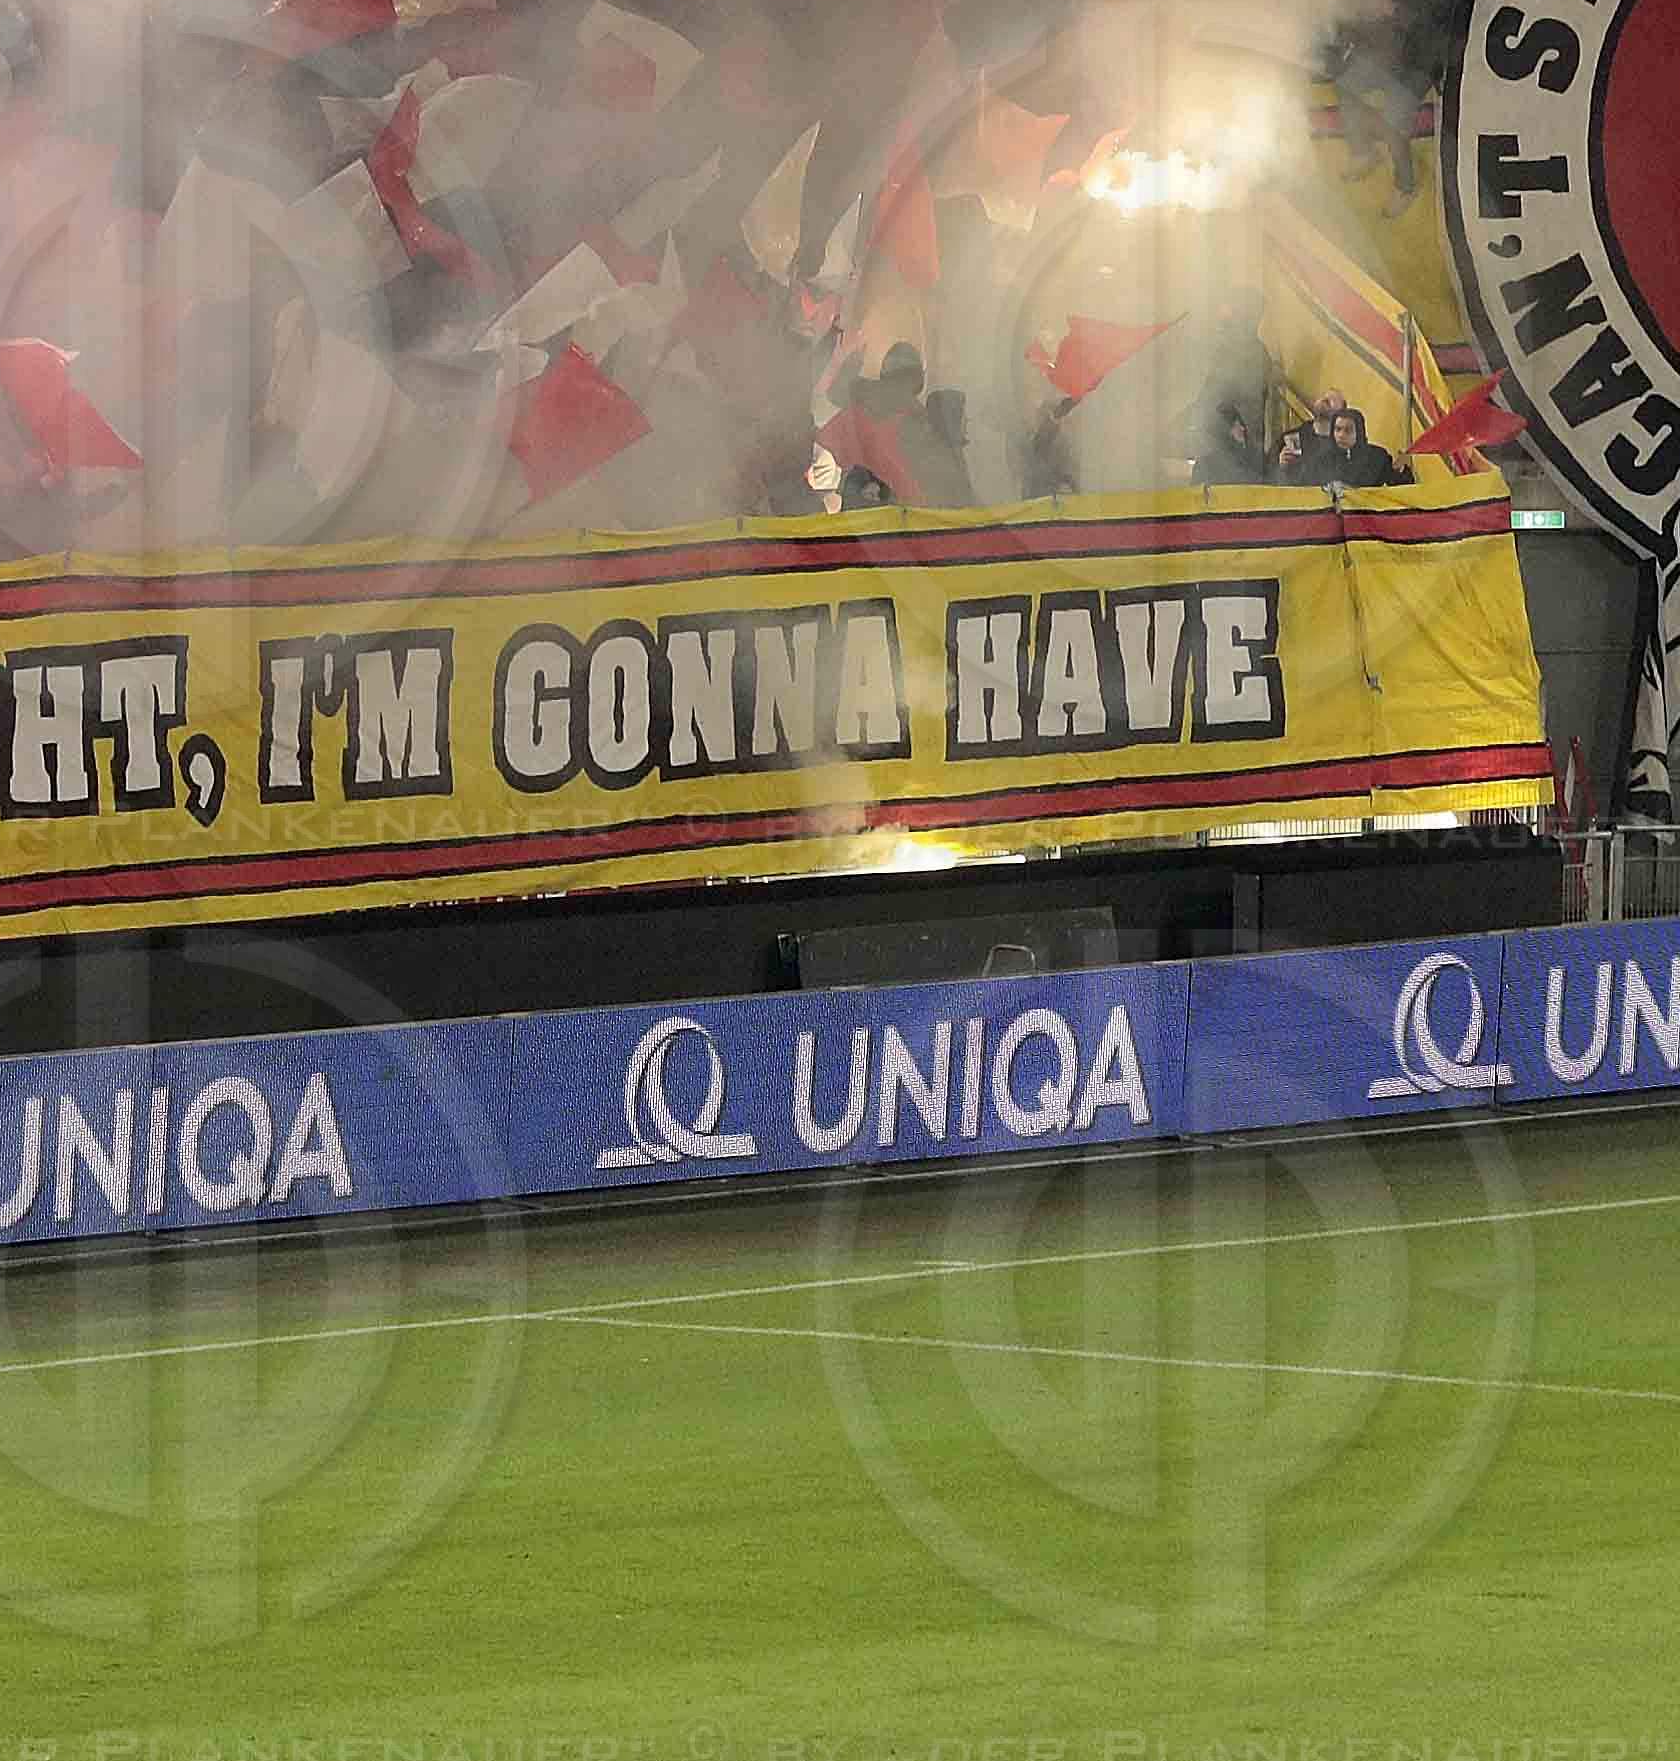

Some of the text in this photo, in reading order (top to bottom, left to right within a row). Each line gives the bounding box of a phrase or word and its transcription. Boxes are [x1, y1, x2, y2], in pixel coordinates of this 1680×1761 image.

[262, 632, 450, 800] I'M
[497, 601, 910, 792] GONNA
[948, 581, 1283, 760] HAVE
[792, 1003, 1151, 1153] UNIQA
